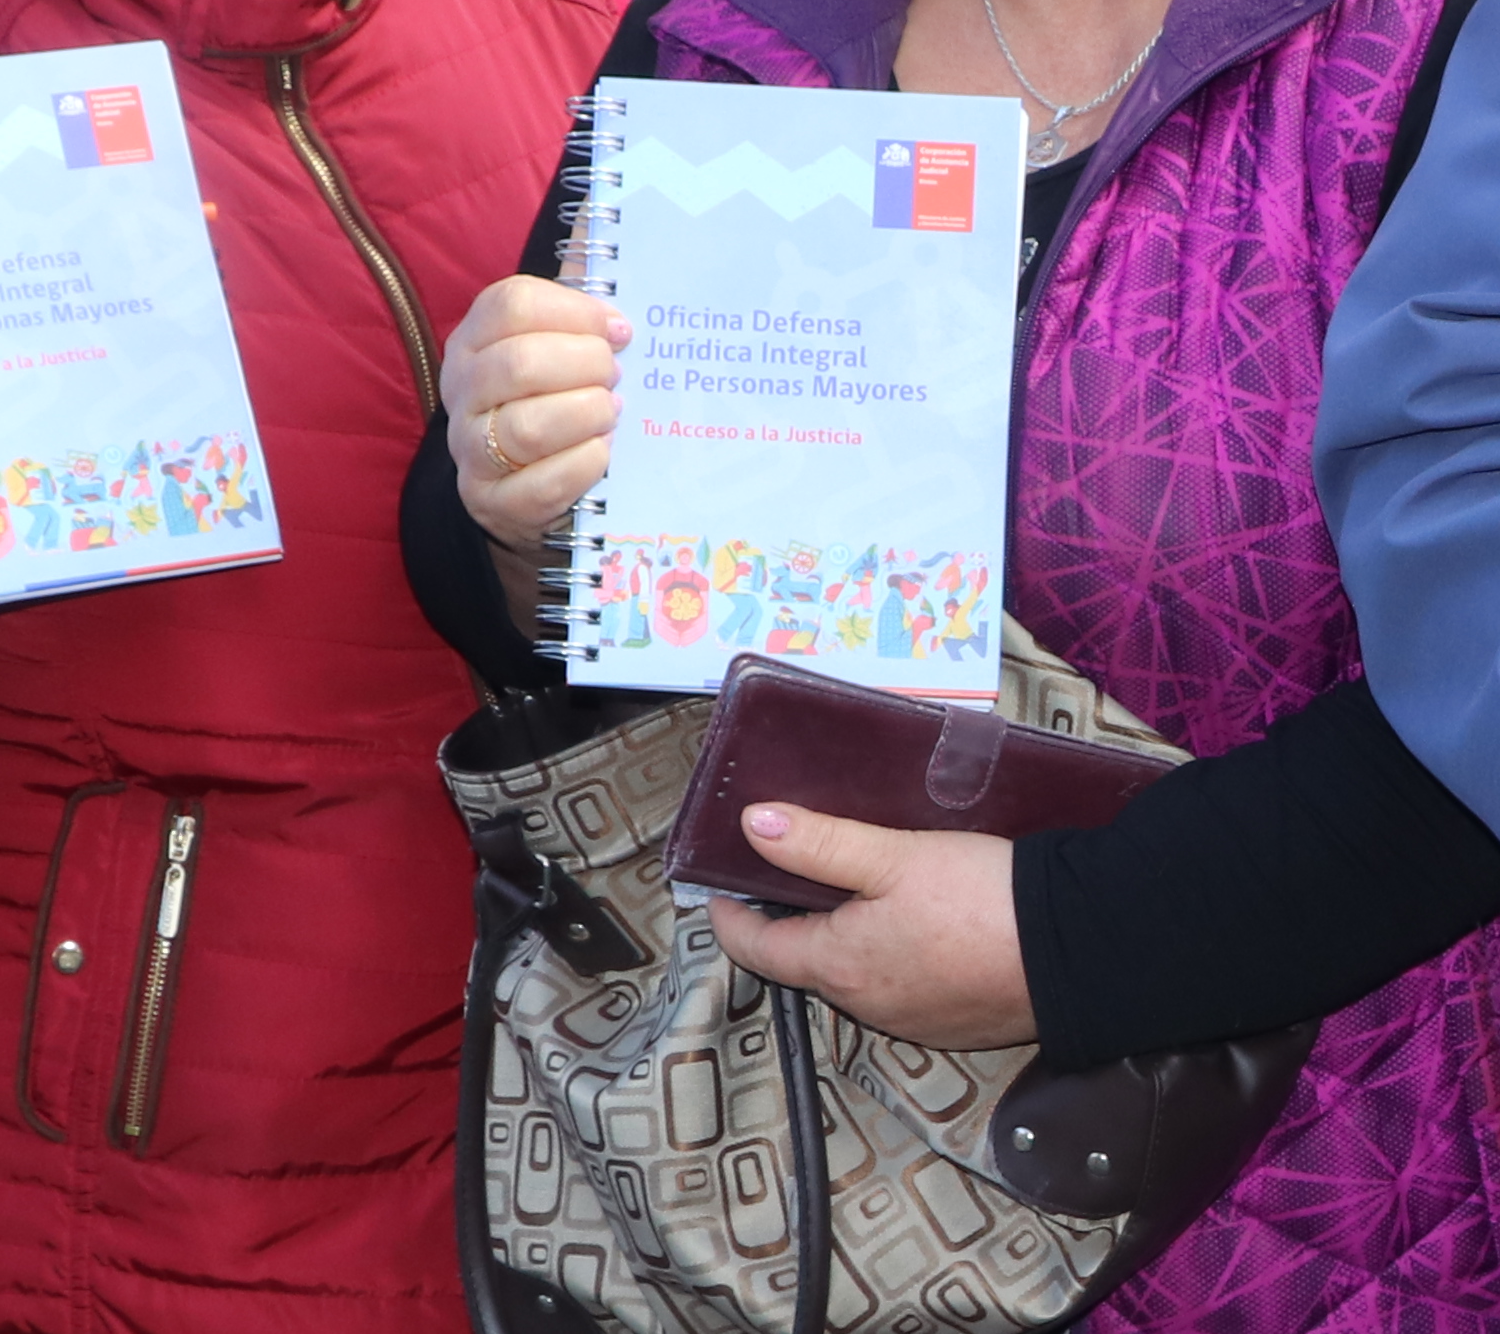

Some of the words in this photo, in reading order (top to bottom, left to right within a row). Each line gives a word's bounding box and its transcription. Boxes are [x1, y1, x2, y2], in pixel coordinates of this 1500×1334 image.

[51, 296, 154, 325] Mayores
[646, 305, 743, 332] Oficina
[752, 309, 862, 336] Defensa
[2, 359, 13, 370] a
[16, 355, 34, 369] la
[39, 346, 108, 366] Justicia
[644, 336, 752, 363] Jurídica
[762, 341, 868, 372] Integral
[643, 368, 676, 391] de
[684, 369, 804, 396] Personas
[812, 375, 928, 405] Mayores
[642, 419, 662, 436] Tu
[668, 421, 738, 440] Acceso
[744, 427, 755, 441] a
[761, 424, 779, 442] la
[785, 426, 862, 445] Justicia
